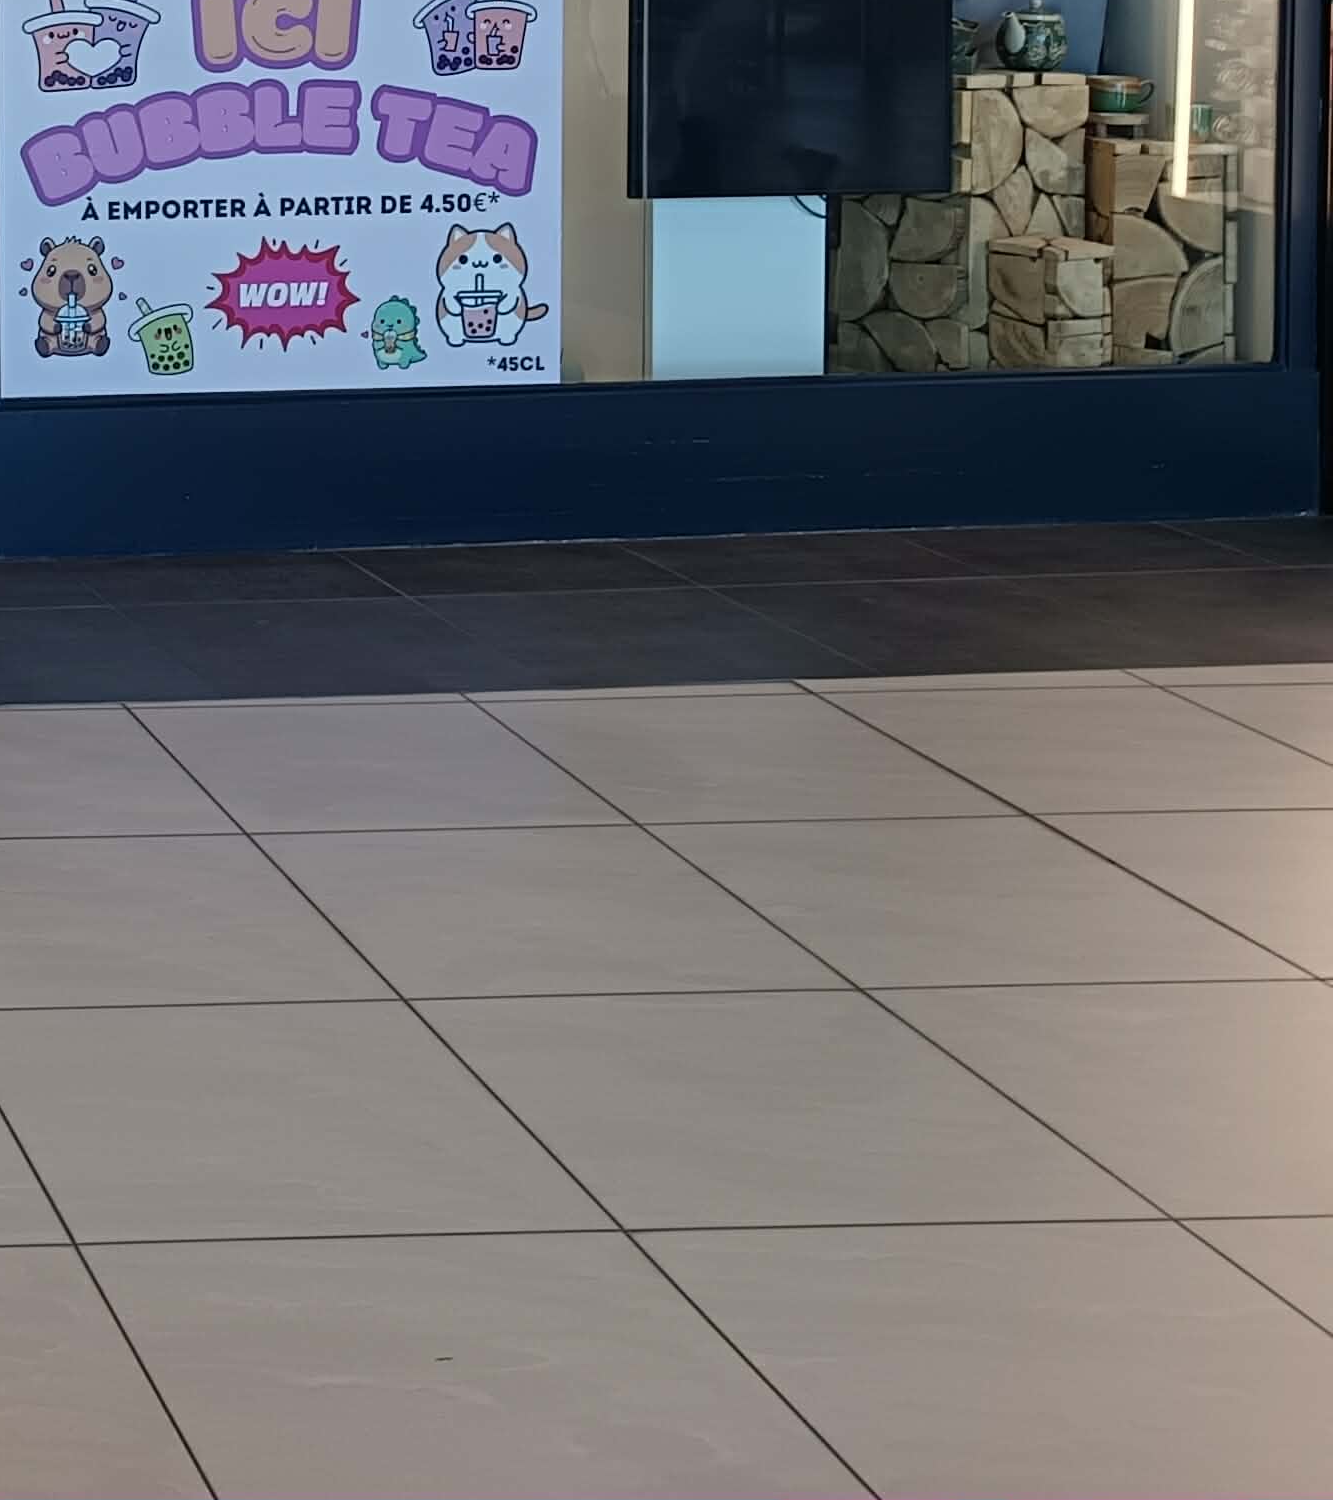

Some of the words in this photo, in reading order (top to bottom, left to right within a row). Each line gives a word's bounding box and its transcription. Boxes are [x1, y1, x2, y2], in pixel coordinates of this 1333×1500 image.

[20, 79, 361, 207] BUBBLE
[372, 83, 539, 197] TEA
[81, 195, 100, 222] À
[108, 199, 246, 222] EMPORTER
[254, 192, 272, 218] À
[279, 195, 372, 217] PARTIR
[380, 194, 413, 215] DE
[238, 281, 331, 308] WOW!
